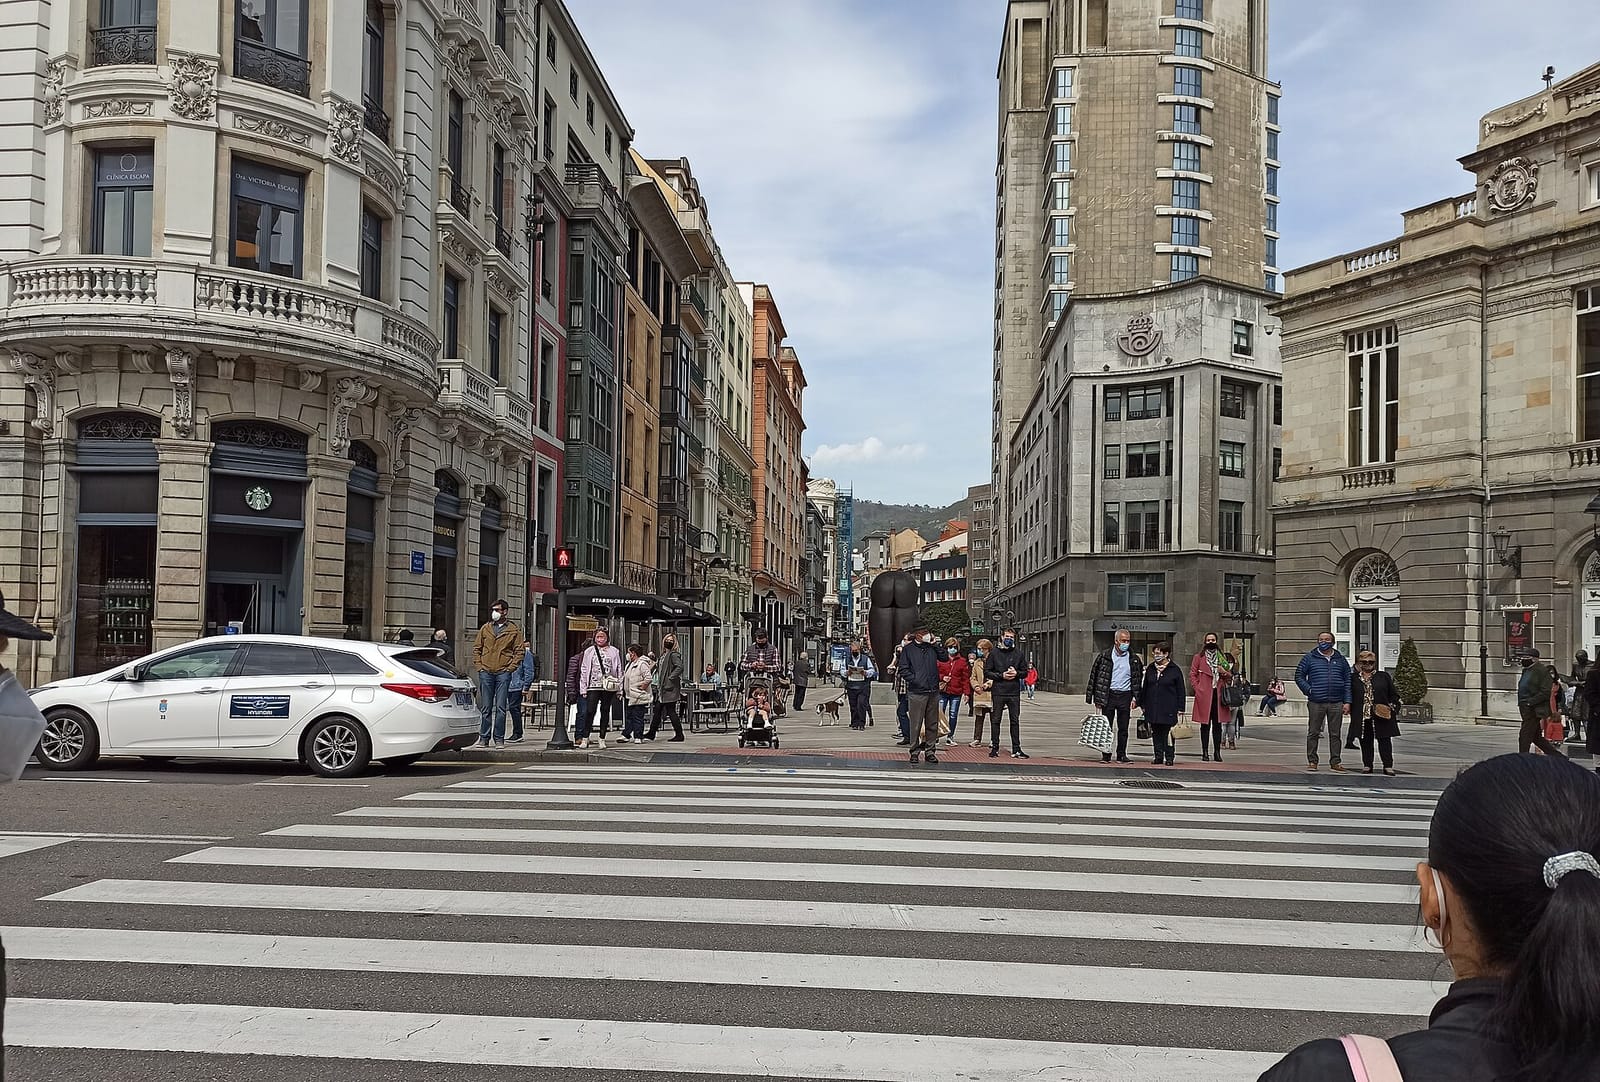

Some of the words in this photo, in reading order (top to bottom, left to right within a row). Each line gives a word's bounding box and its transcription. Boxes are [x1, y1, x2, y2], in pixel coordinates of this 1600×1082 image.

[248, 176, 277, 188] VICTORIA
[277, 183, 299, 194] ESCAPA
[433, 525, 456, 538] ARBUCKS
